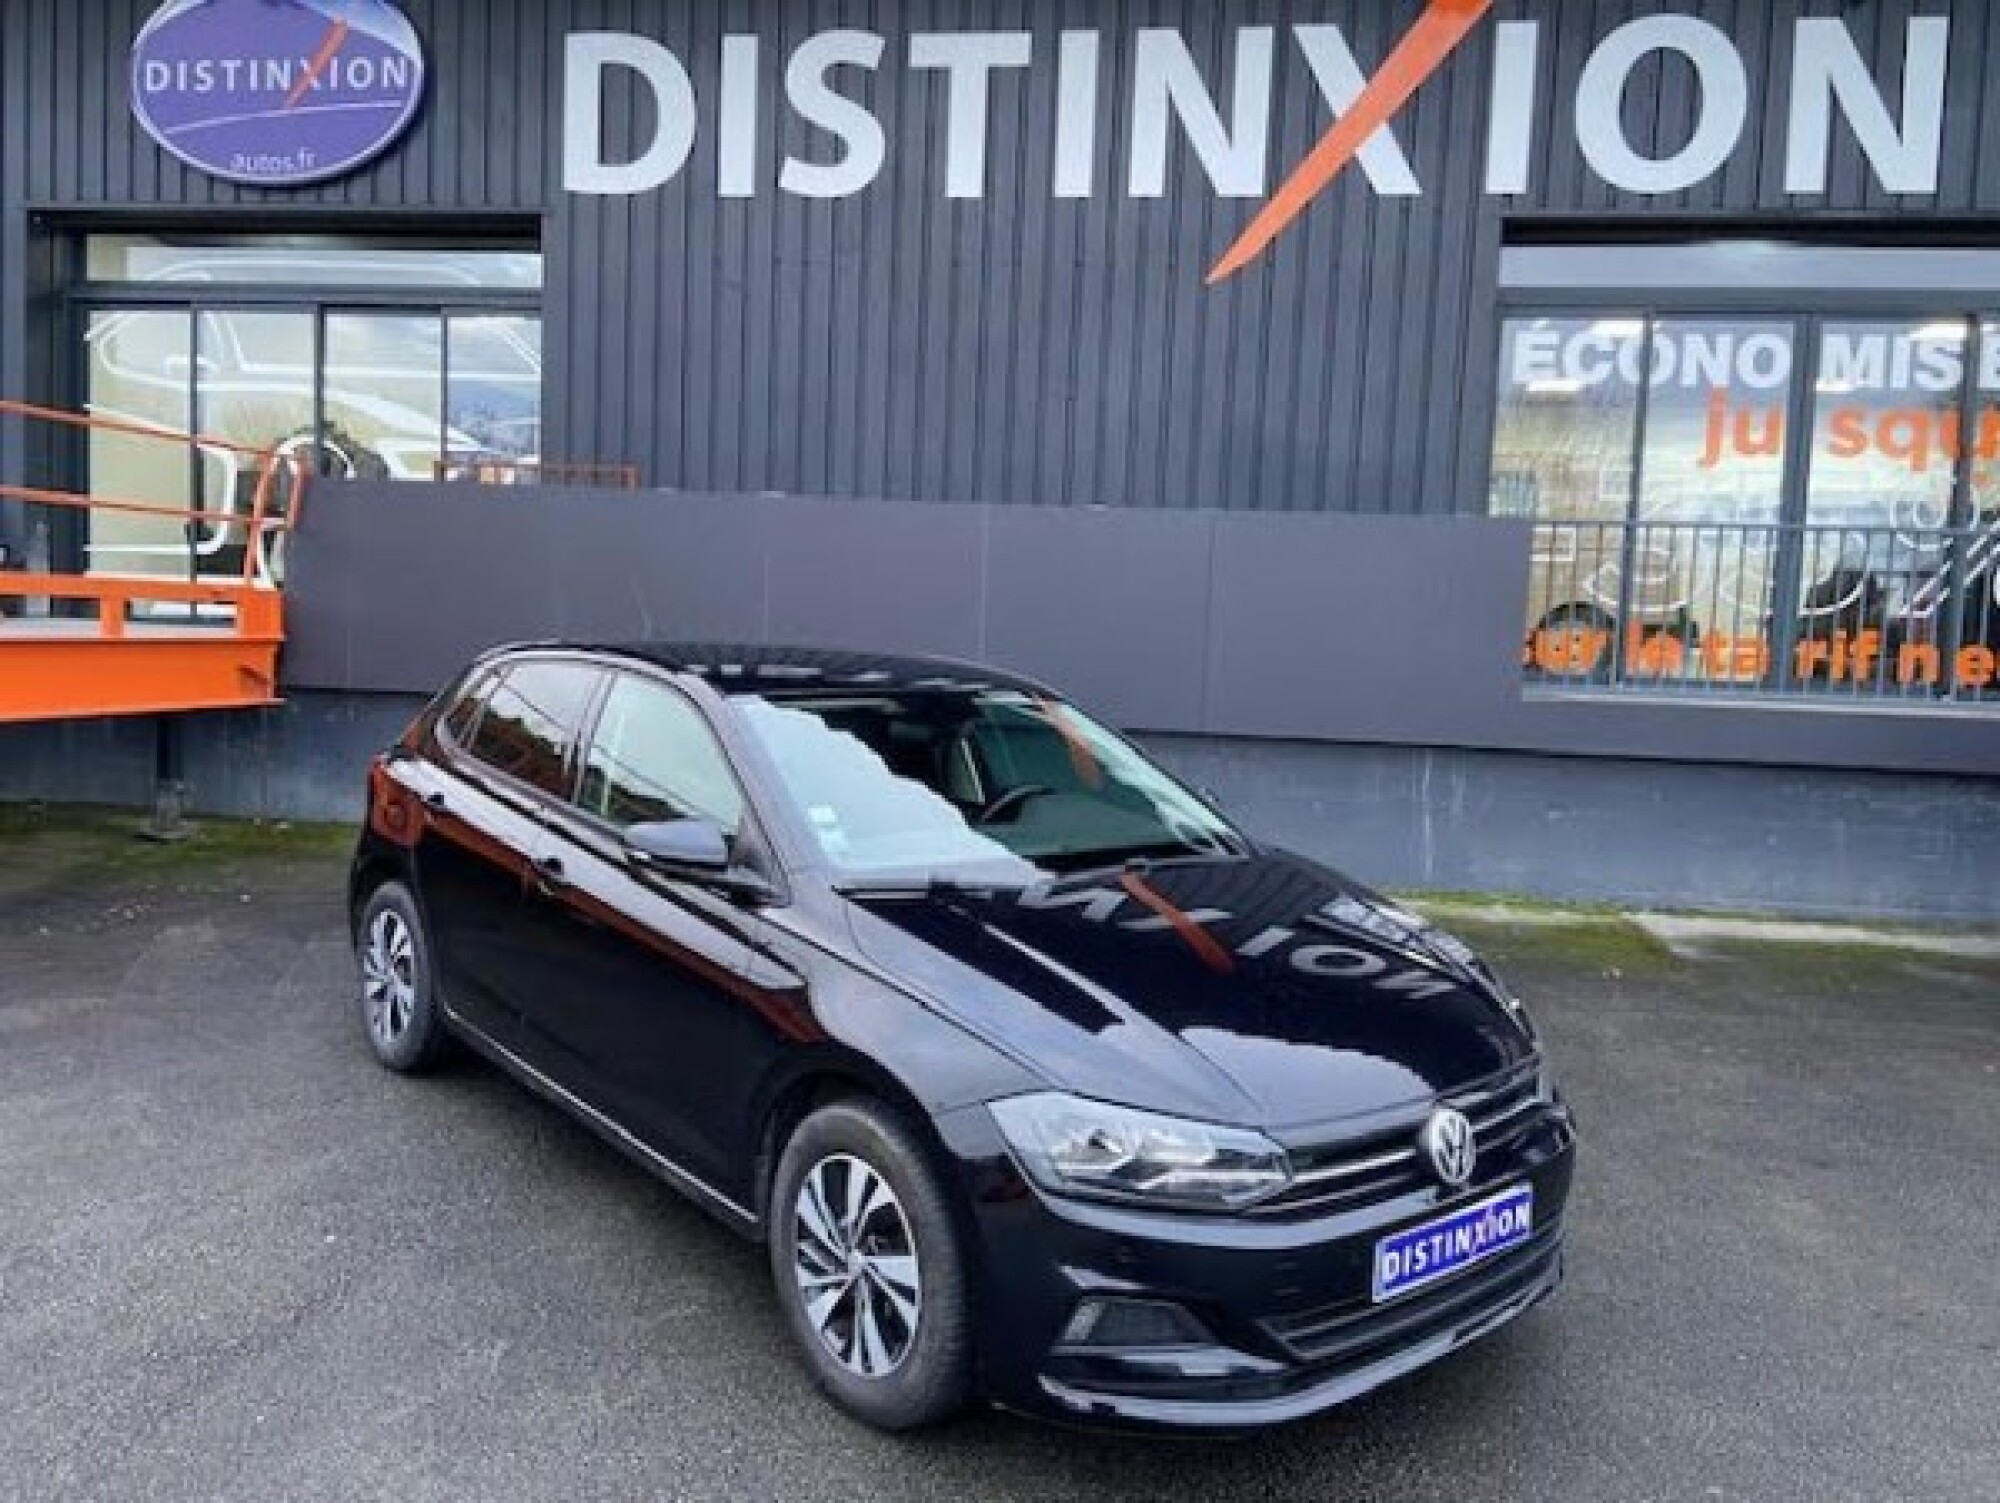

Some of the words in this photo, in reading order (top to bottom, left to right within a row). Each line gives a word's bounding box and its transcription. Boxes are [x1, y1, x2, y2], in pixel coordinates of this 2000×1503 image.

[145, 42, 407, 104] DISTINXION
[563, 0, 1949, 283] DISTINXION
[1381, 1200, 1530, 1281] DISTINXION
